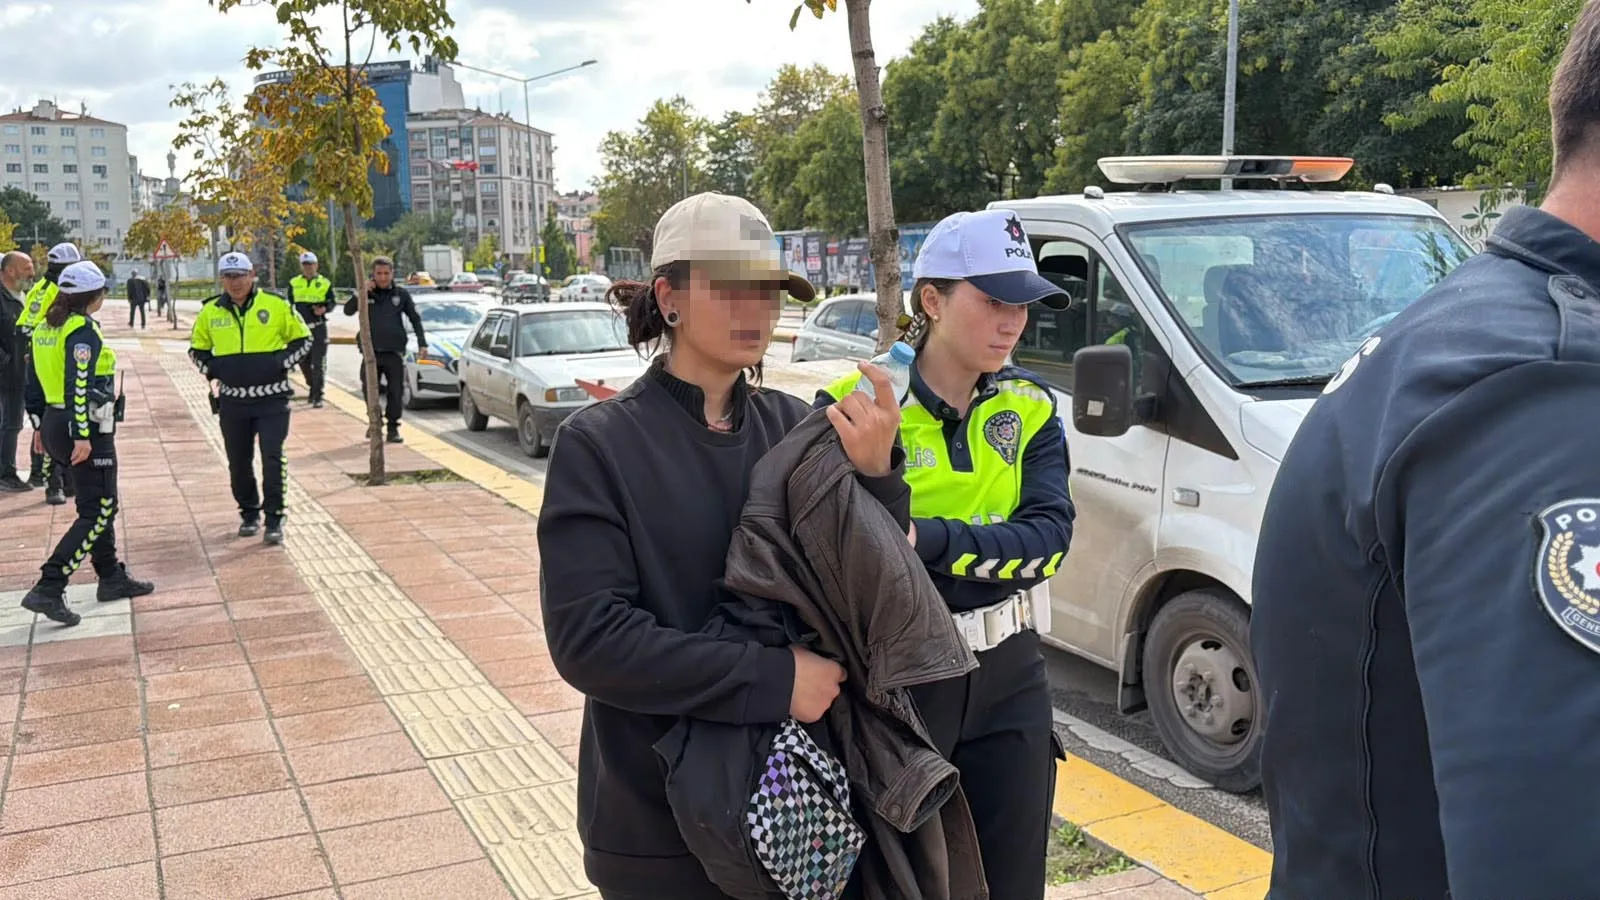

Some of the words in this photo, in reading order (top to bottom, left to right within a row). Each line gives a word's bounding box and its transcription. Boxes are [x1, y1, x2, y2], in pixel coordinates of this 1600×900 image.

[1004, 248, 1032, 259] POL
[1555, 508, 1597, 530] PO
[1573, 613, 1600, 632] GENE
